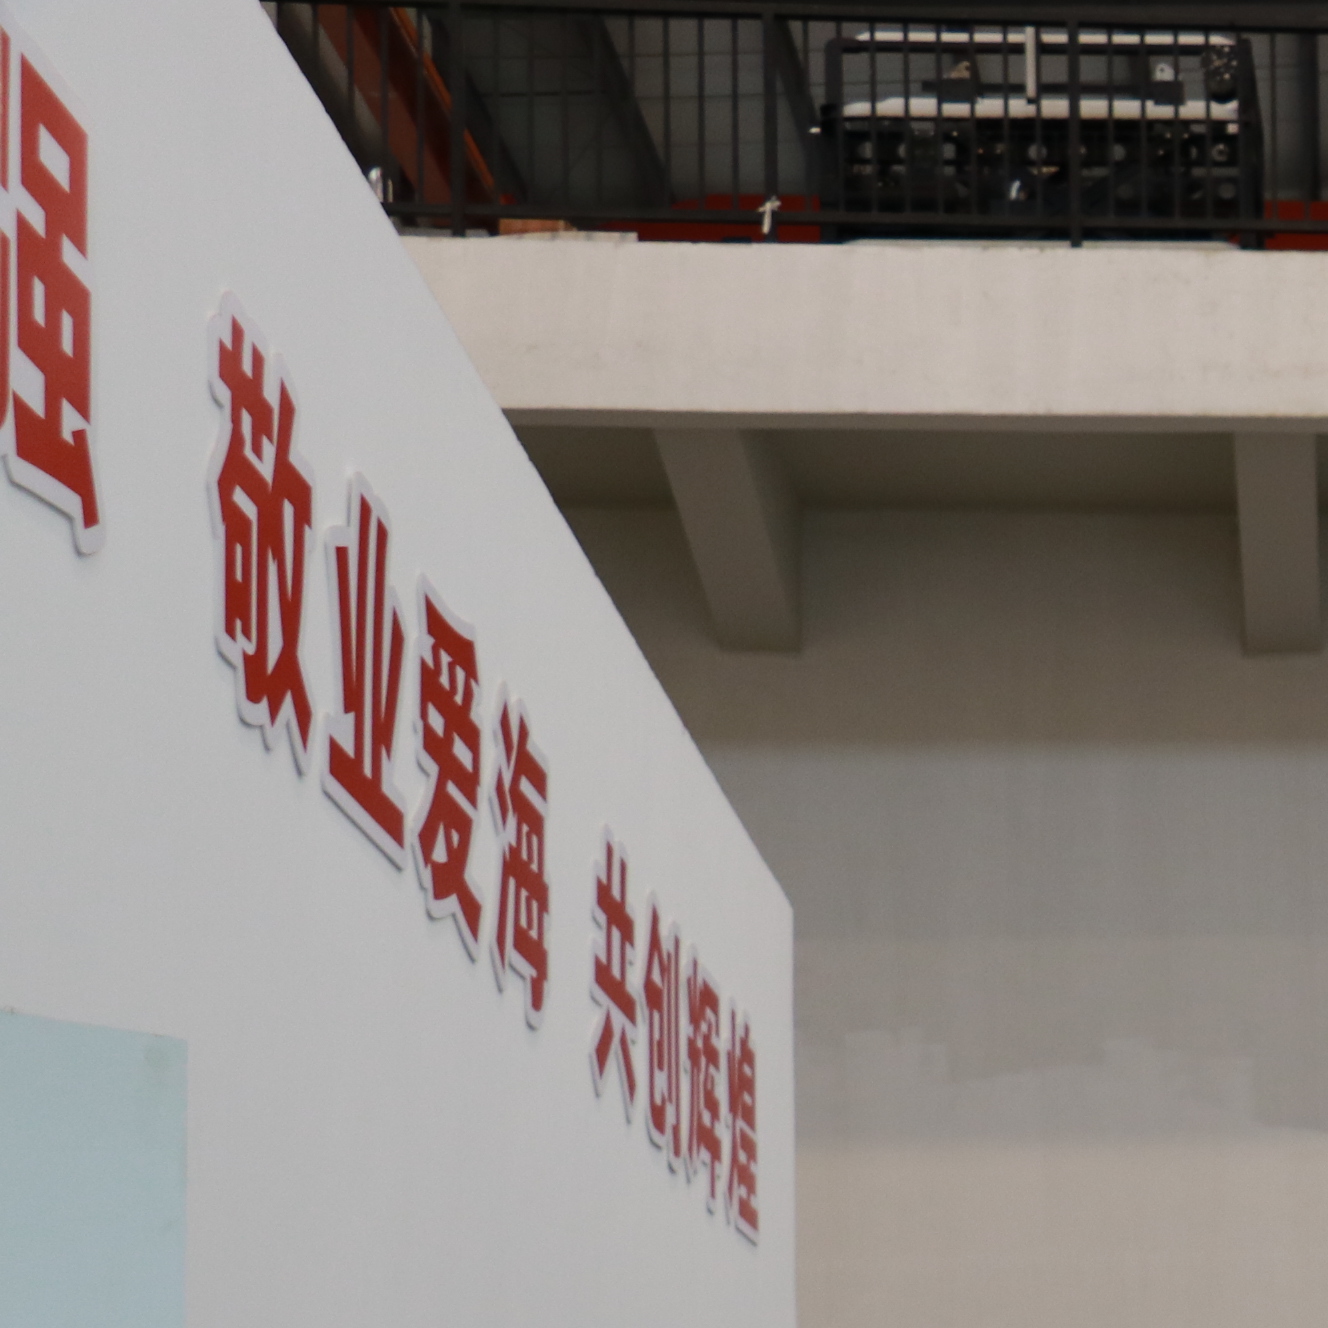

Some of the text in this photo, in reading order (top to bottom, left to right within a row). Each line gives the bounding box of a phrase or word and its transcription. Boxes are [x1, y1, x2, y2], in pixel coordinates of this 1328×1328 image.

[217, 315, 550, 1014] 敬业爱海
[592, 840, 760, 1235] 共创辉煌
